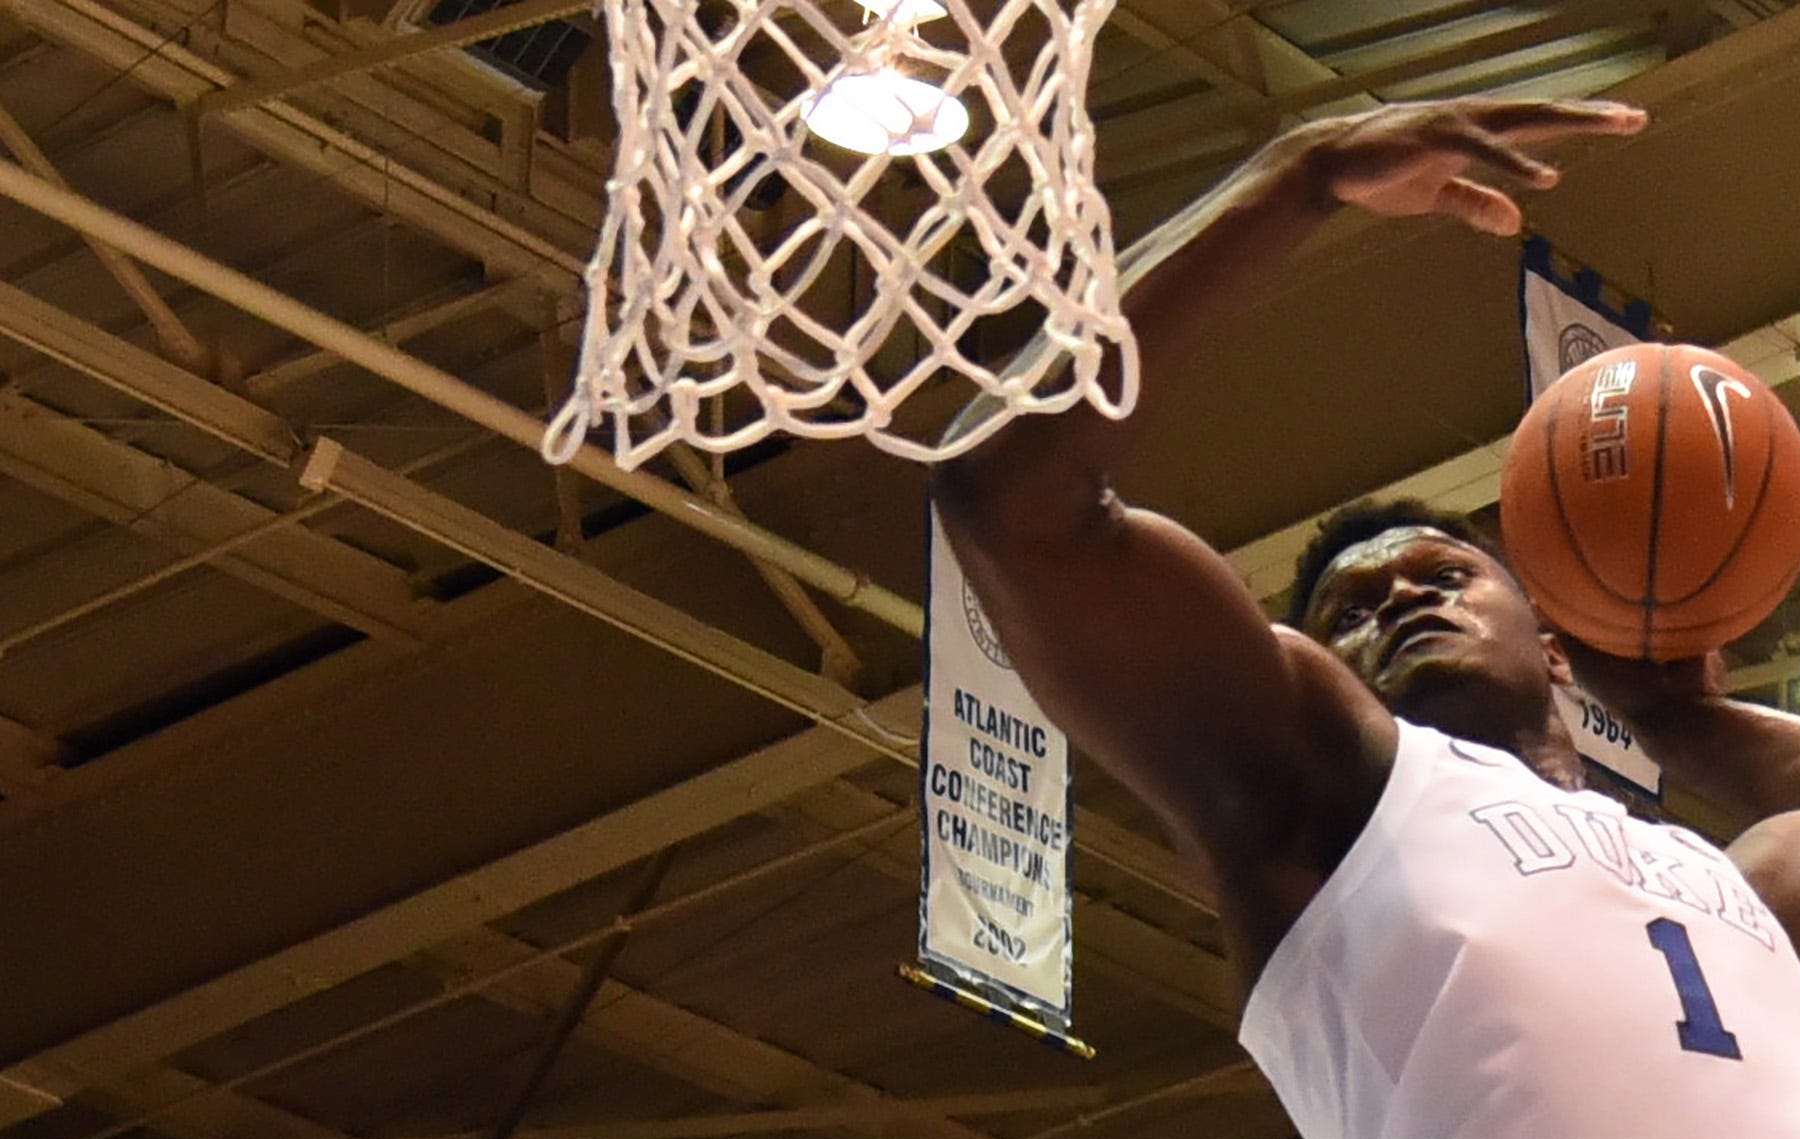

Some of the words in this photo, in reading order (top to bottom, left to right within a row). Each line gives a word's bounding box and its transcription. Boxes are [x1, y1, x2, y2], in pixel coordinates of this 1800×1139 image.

[954, 688, 1047, 758] ATLANTIC
[970, 737, 1032, 793] COAST
[931, 763, 1063, 851] CONFERENCE
[937, 808, 1053, 892] CHAMPIONS
[1468, 801, 1776, 952] DUKE
[1646, 916, 1744, 1062] 1
